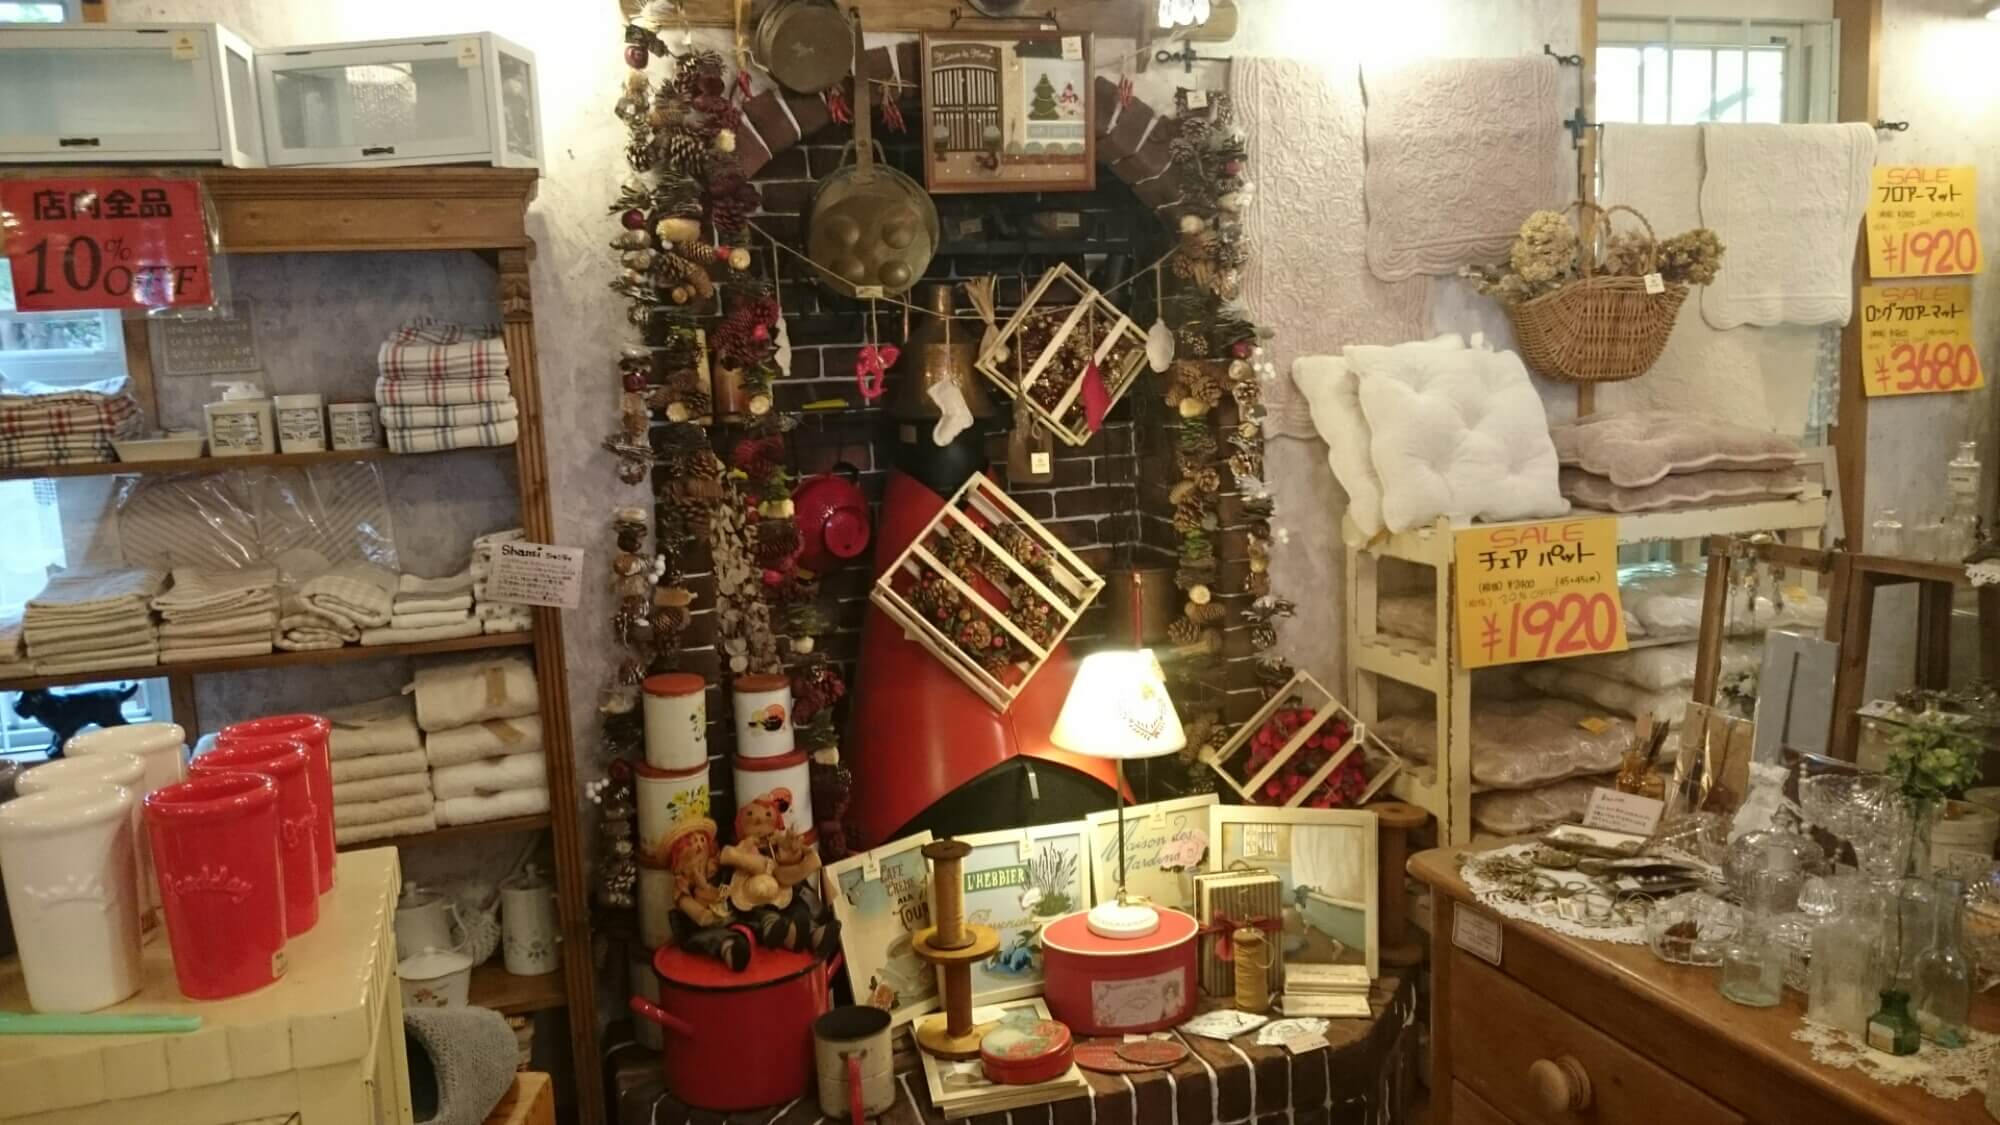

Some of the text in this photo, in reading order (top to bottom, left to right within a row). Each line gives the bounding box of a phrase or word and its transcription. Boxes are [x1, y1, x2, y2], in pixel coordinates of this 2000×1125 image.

[1887, 168, 1951, 184] SALE
[33, 188, 173, 220] 店内全品
[1877, 183, 1962, 203] フロアーマット
[1881, 287, 1951, 301] SALE
[1490, 523, 1584, 549] SALE
[1481, 592, 1618, 662] ¥1920
